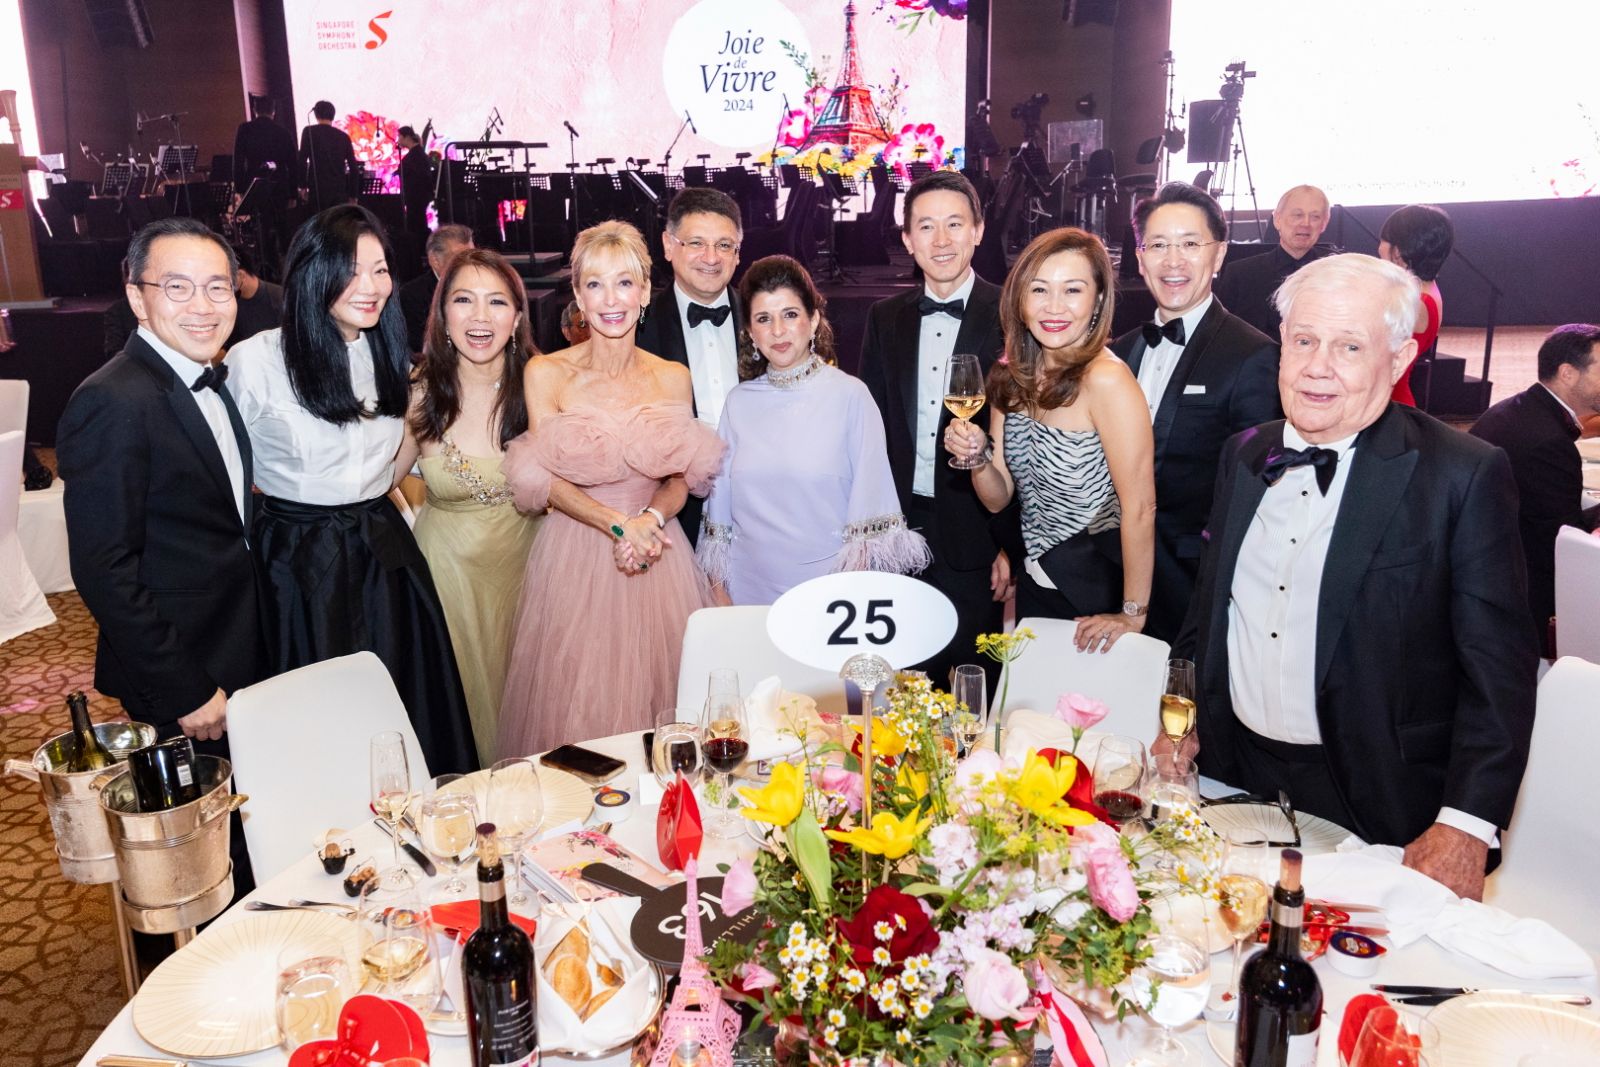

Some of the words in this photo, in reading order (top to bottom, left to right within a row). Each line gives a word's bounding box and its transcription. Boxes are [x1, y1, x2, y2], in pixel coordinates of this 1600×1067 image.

[316, 21, 354, 29] SINGAPORE
[318, 42, 356, 50] ORCHESTRA
[718, 29, 764, 55] Joie
[733, 56, 747, 69] de
[700, 61, 776, 93] Vivre
[724, 99, 754, 112] 2024
[826, 599, 896, 646] 25
[658, 891, 722, 939] 163
